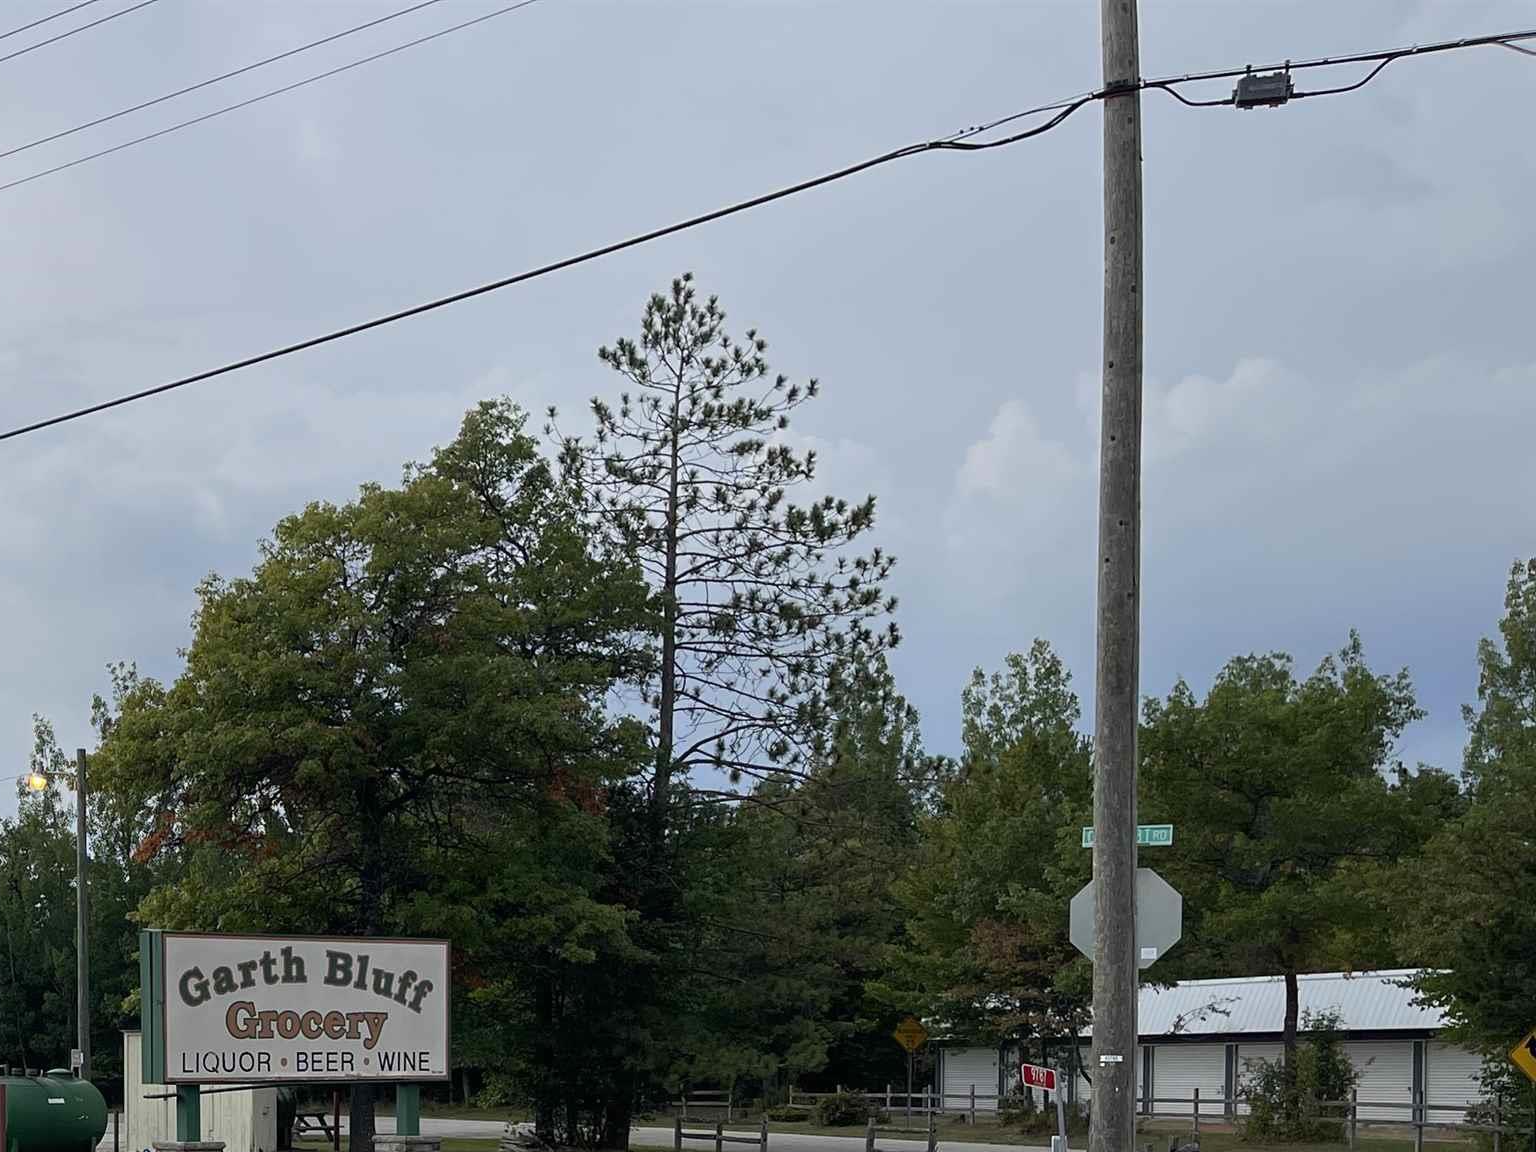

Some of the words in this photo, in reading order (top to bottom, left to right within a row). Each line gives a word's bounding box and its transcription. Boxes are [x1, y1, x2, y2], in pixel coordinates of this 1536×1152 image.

[178, 946, 308, 1007] Garth
[324, 949, 434, 1014] Bluff
[226, 1001, 388, 1050] Grocery
[182, 1051, 271, 1073] LIQUOR
[296, 1051, 354, 1072] BEER
[377, 1051, 430, 1072] WINE
